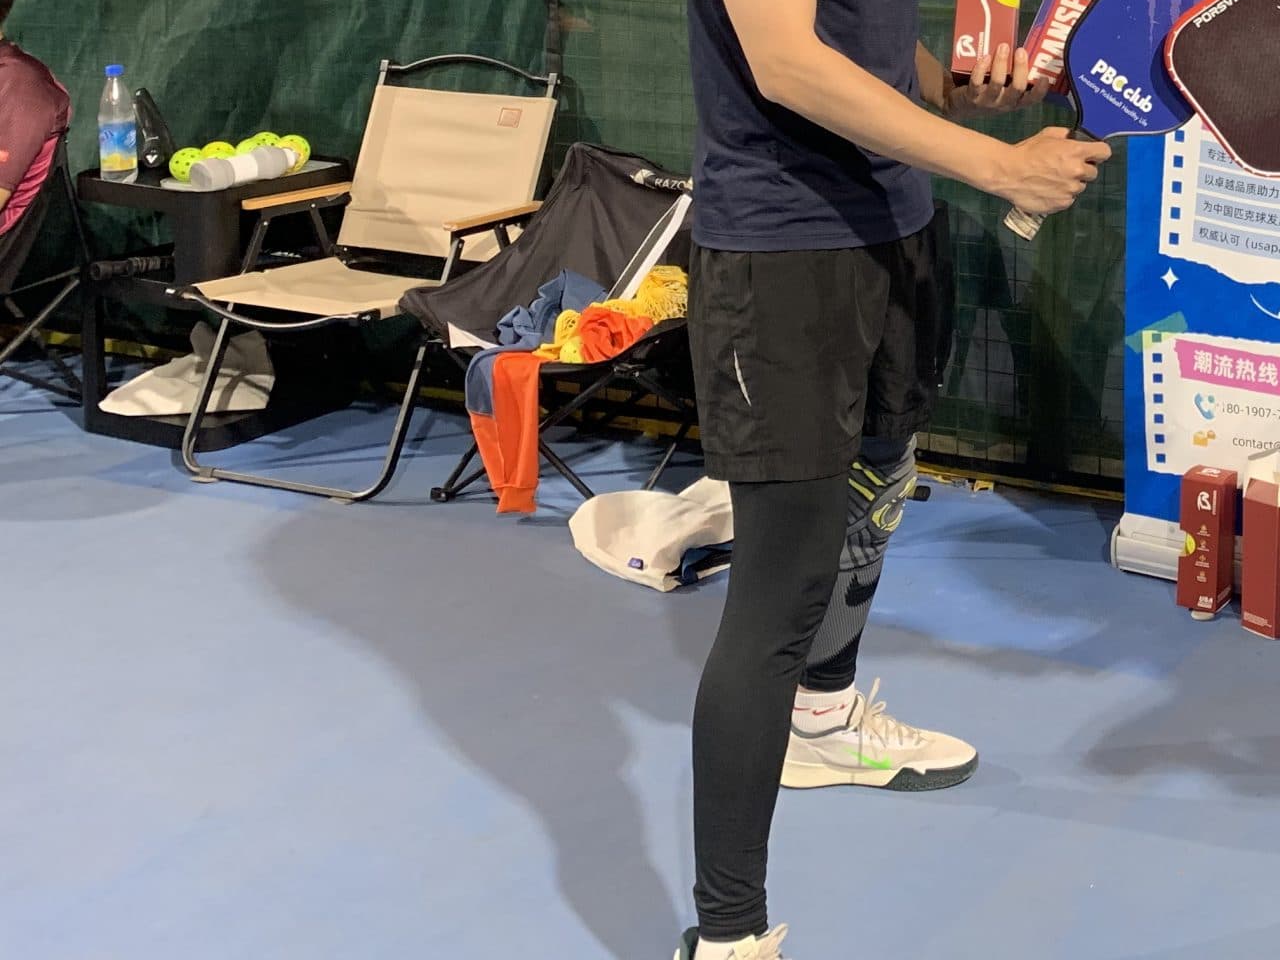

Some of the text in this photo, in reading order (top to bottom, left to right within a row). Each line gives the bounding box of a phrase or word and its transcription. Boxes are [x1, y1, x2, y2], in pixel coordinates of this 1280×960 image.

[1090, 58, 1152, 113] PBC club
[1207, 148, 1234, 165] 专注
[1193, 350, 1280, 386] 潮流热线
